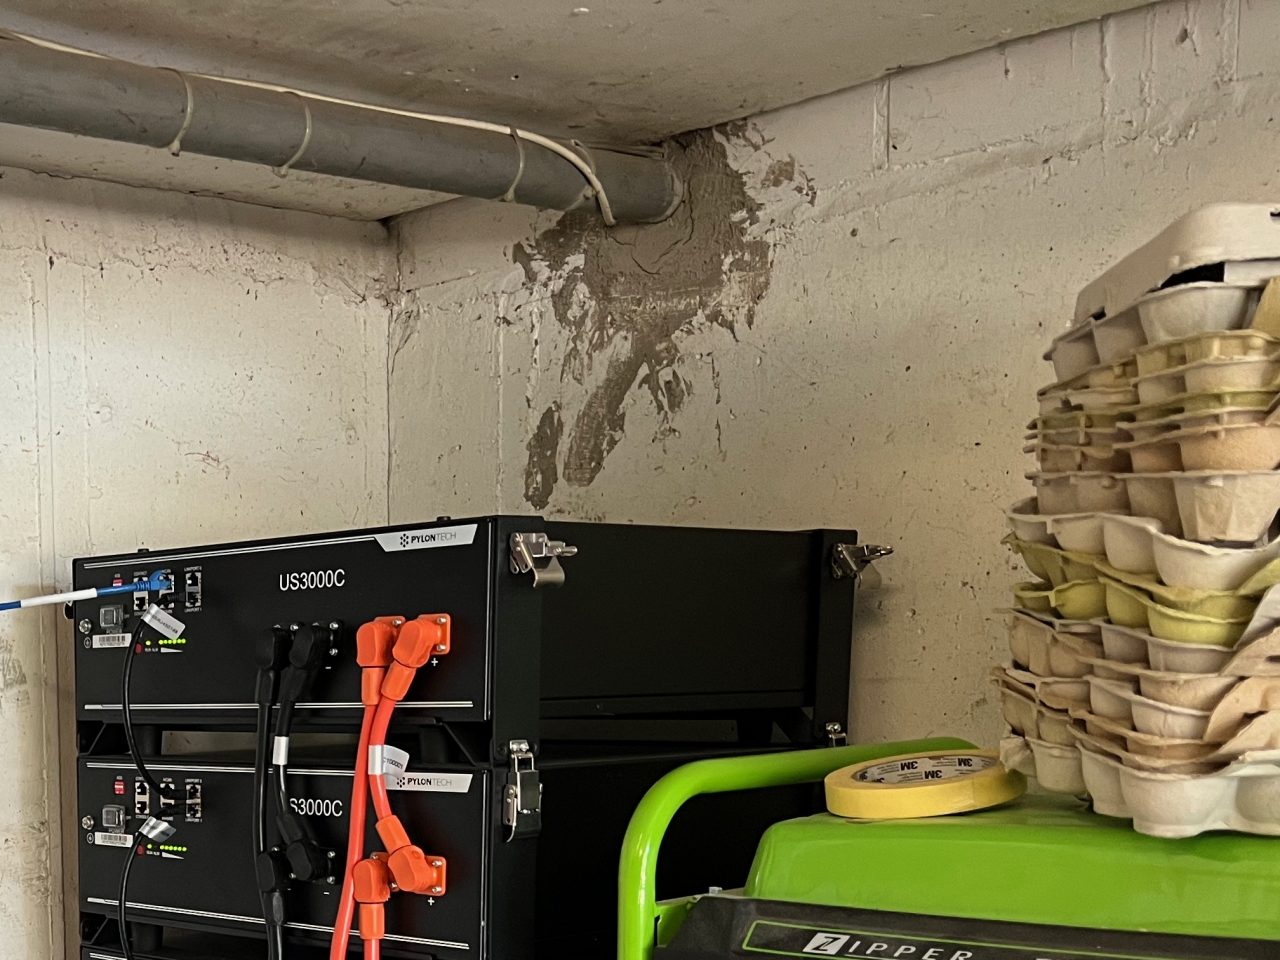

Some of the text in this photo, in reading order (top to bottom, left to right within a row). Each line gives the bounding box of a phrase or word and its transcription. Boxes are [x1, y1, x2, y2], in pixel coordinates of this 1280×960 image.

[411, 532, 457, 544] PYLONTECH
[279, 568, 346, 592] US3000C
[900, 760, 918, 771] 3M
[957, 758, 973, 768] 3M
[924, 769, 942, 780] 3M
[407, 777, 452, 787] PYLONTECH
[290, 798, 343, 817] S3000C
